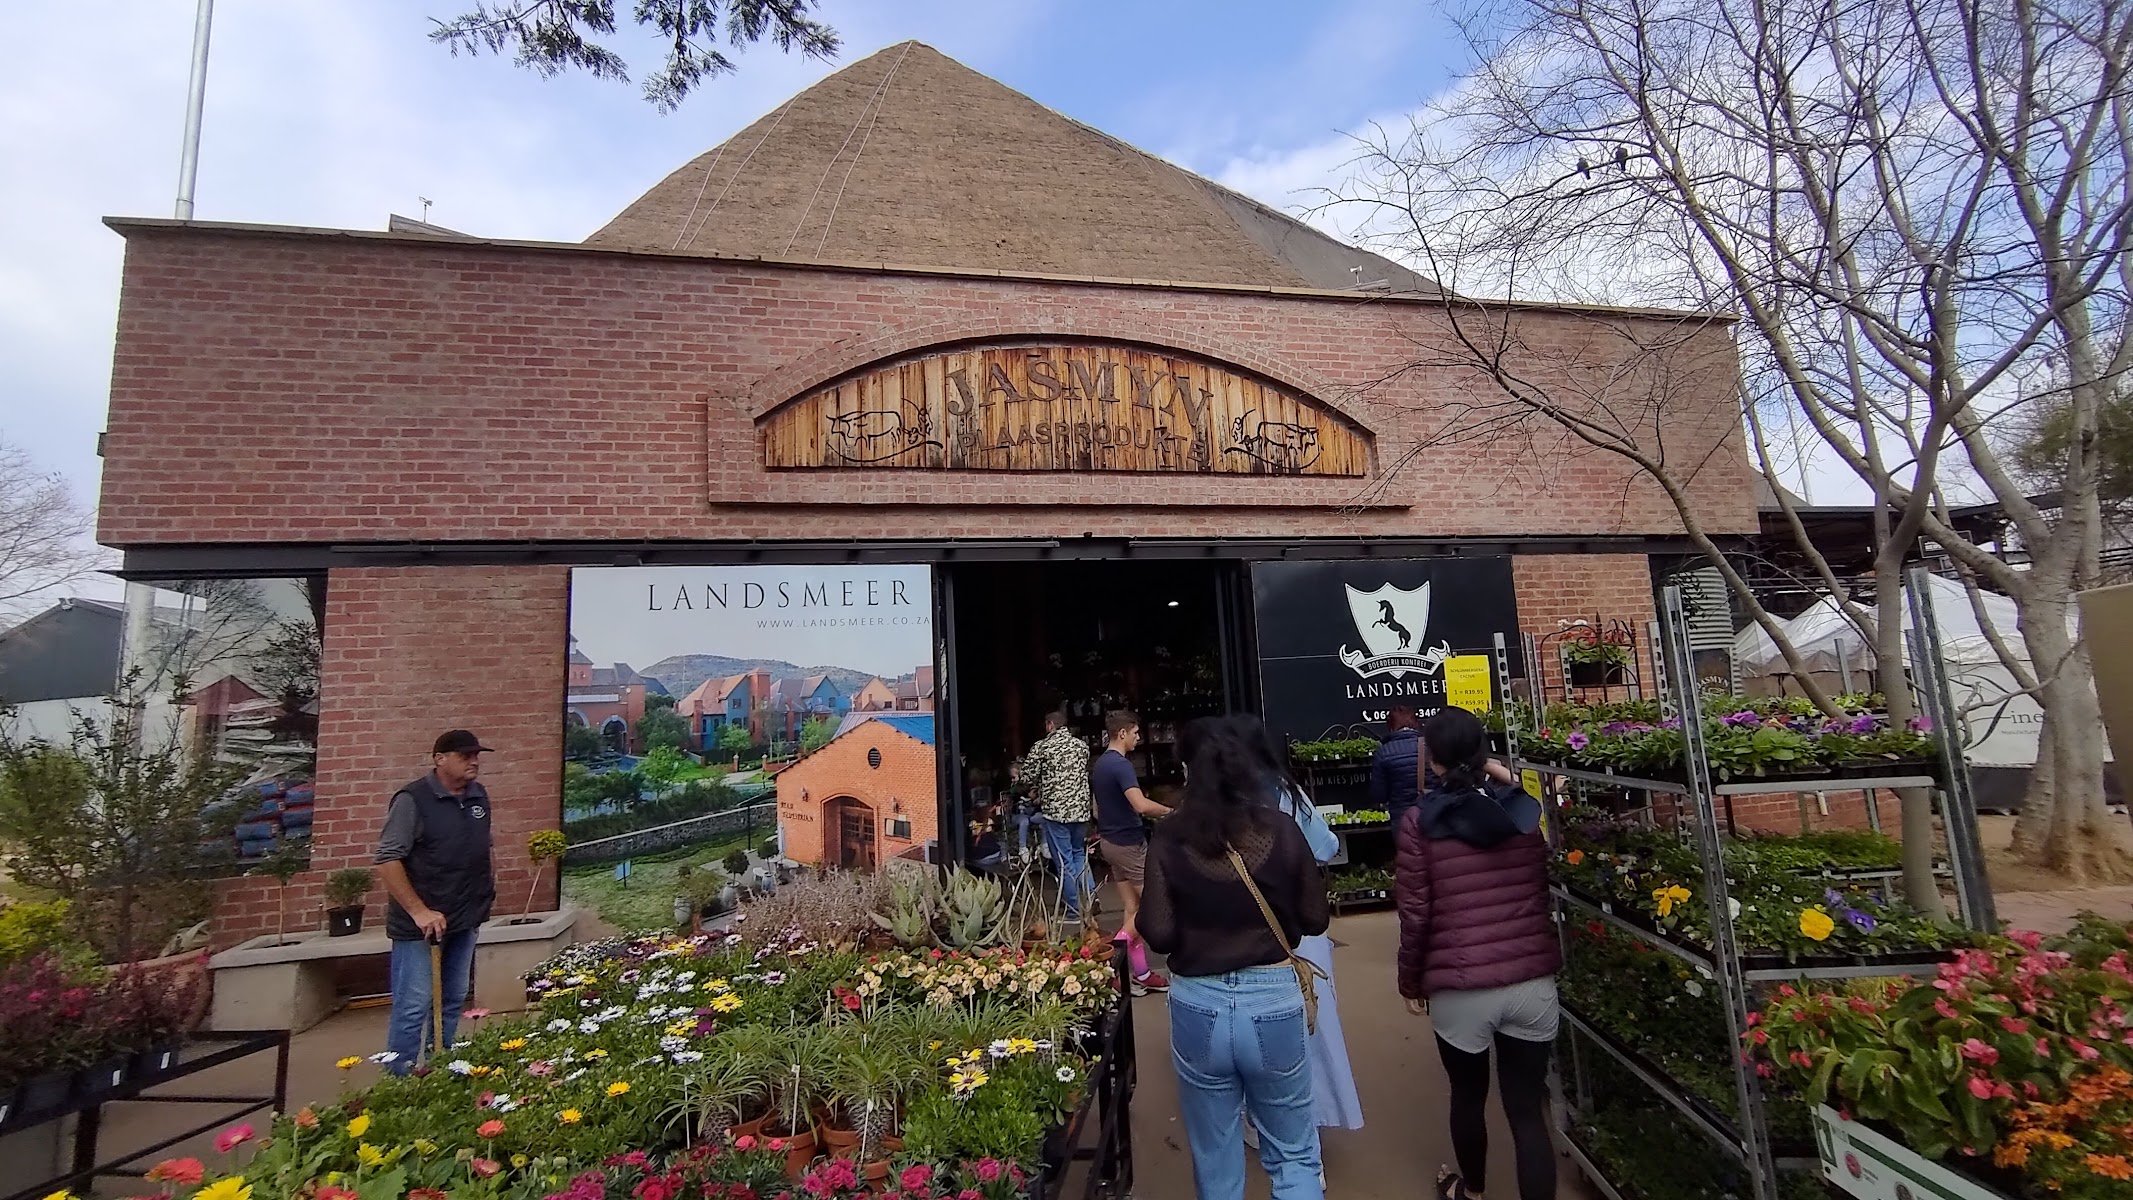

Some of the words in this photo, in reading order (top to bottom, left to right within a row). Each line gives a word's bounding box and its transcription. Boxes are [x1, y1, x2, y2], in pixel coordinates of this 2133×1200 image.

[946, 358, 1214, 428] JASMYN
[957, 421, 1206, 463] PLAASPRODUKTE
[648, 580, 912, 611] LANDSMEER
[756, 616, 930, 628] WWW.LANDSMEER.CO.ZA
[1327, 774, 1347, 785] KIES
[1350, 772, 1366, 785] JOU
